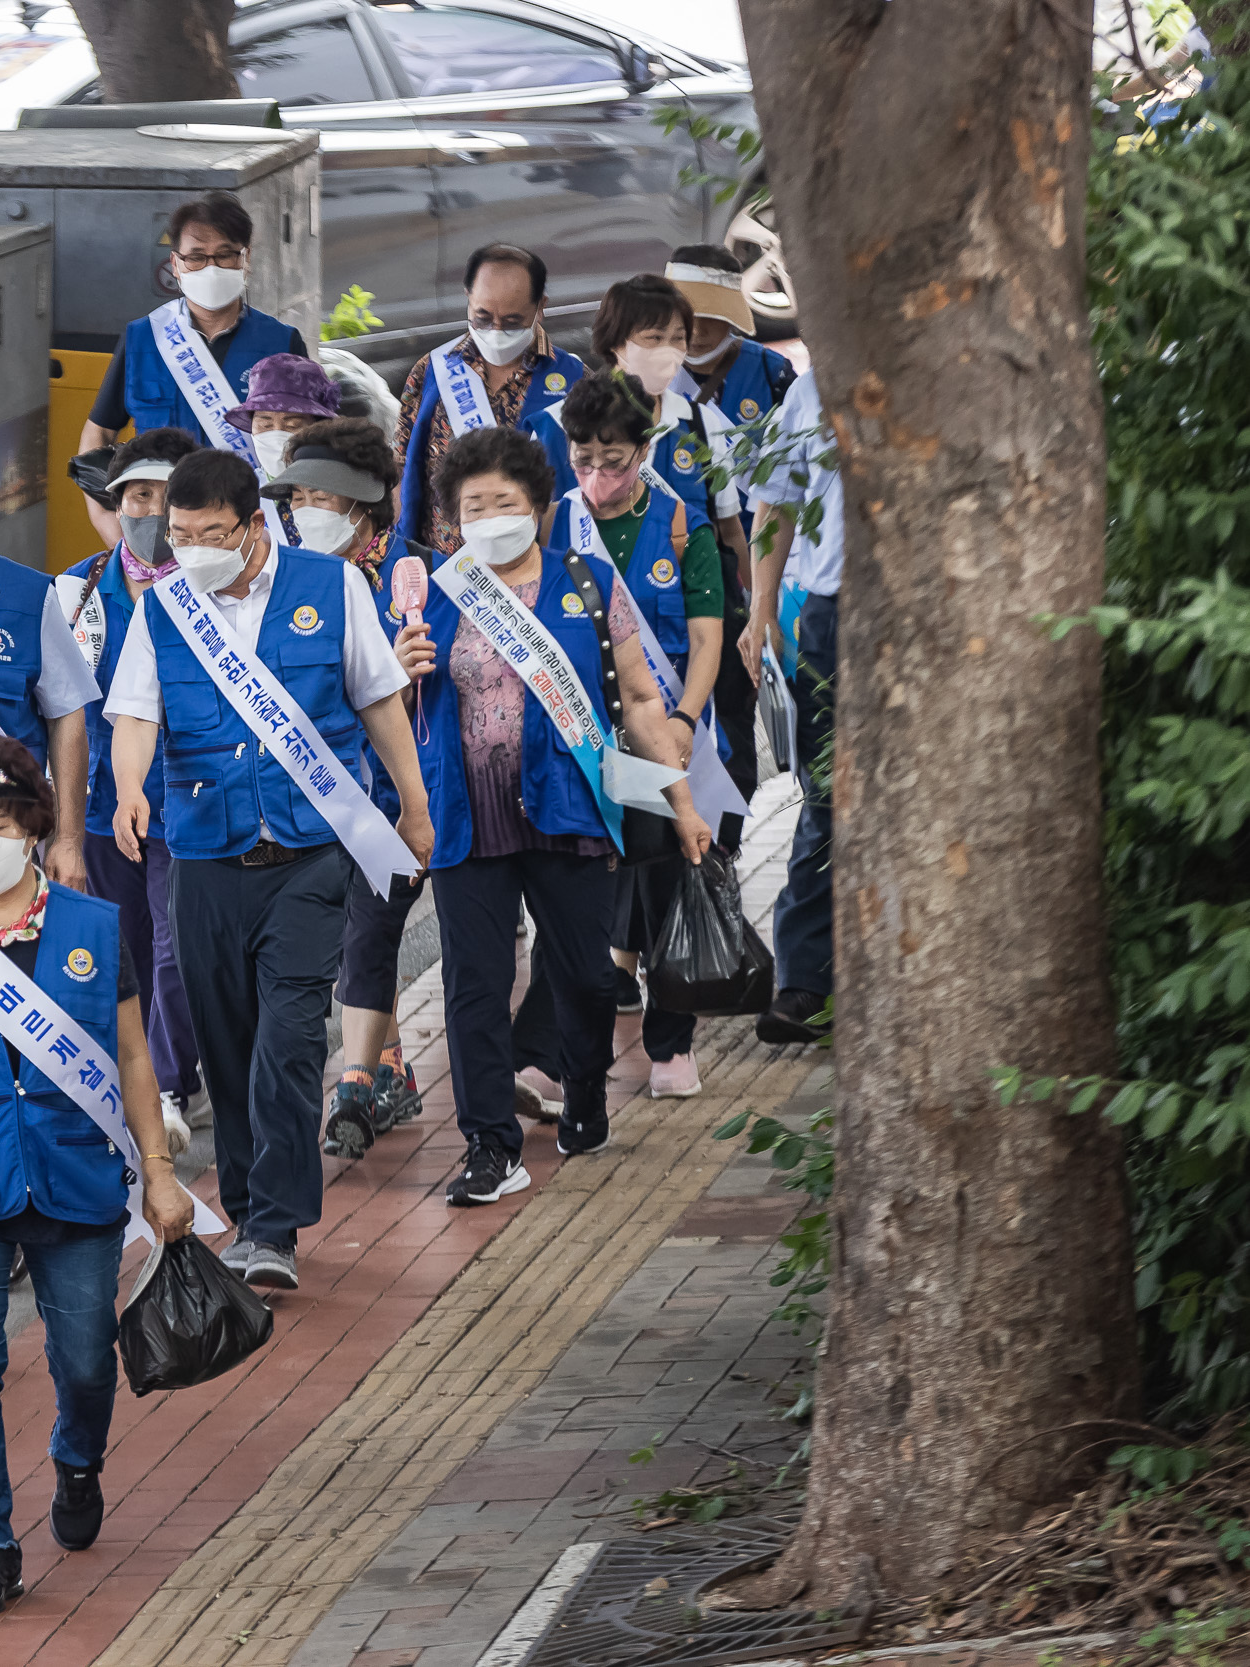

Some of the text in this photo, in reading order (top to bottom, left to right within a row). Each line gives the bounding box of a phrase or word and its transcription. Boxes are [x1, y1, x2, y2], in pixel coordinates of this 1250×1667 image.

[169, 578, 337, 797] 법질서 확립을 위한 기초질서 지키기 운동
[459, 588, 530, 664] 마스크착용
[532, 669, 583, 746] 철저히!
